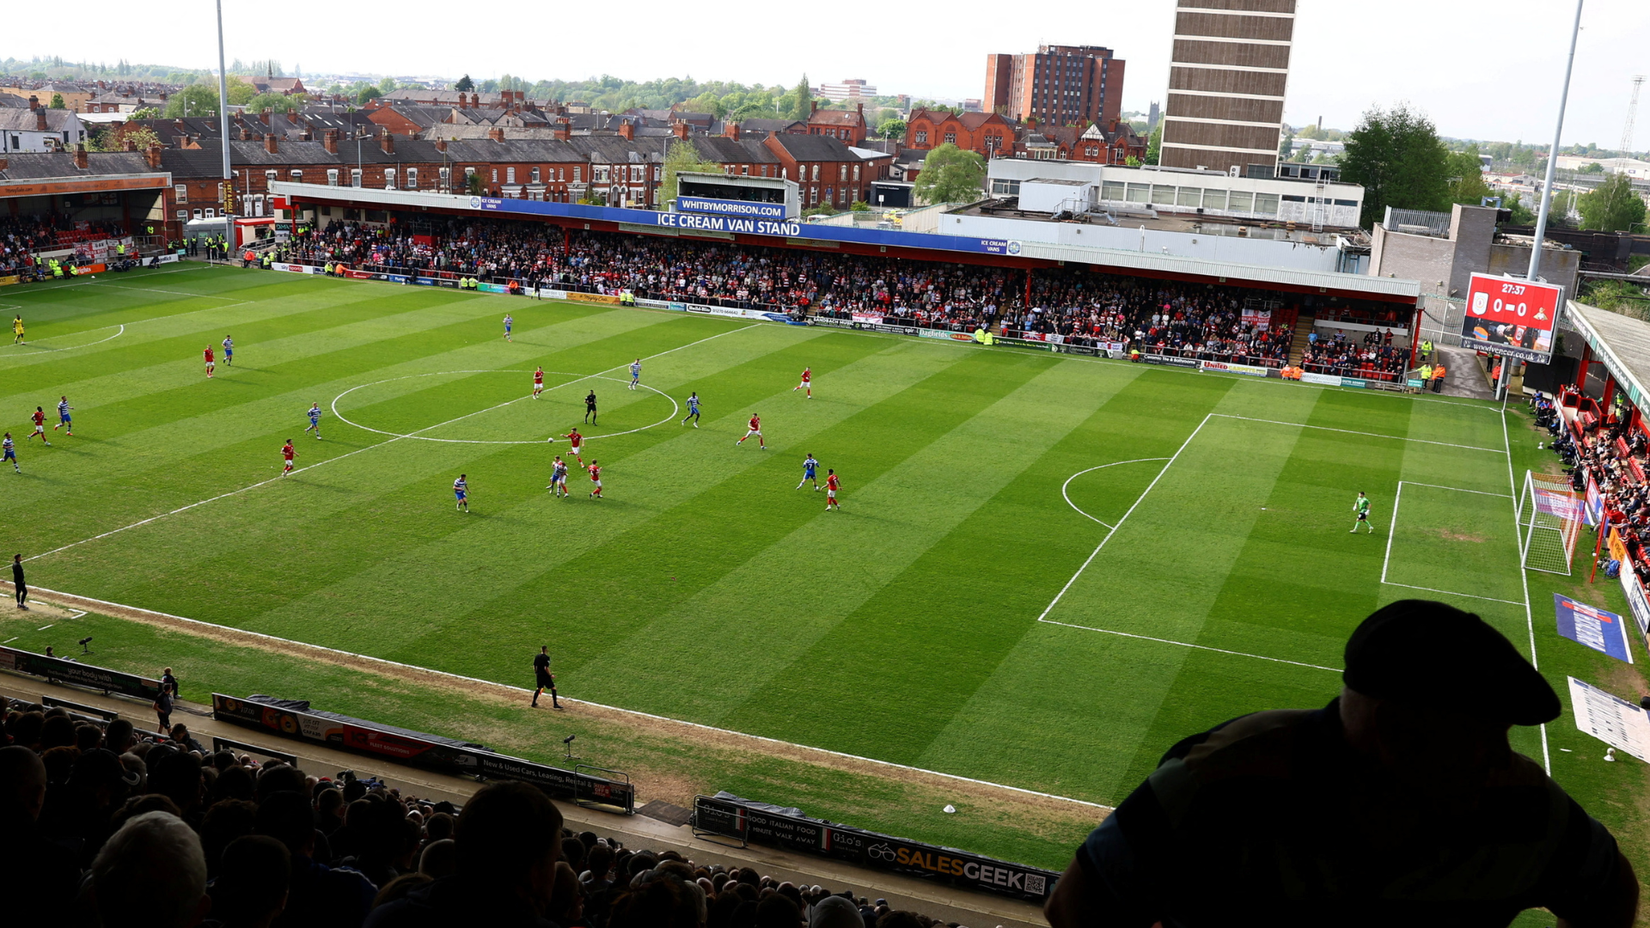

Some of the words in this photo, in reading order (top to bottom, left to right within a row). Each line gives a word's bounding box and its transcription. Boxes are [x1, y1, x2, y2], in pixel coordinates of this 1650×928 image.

[682, 200, 781, 216] WHITBYMORRISON.COM
[658, 213, 676, 226] ICE
[678, 215, 724, 230] CREAM
[727, 218, 754, 232] VAN
[758, 221, 800, 236] STAND
[1502, 283, 1526, 295] 27:37
[1493, 298, 1503, 312] 0
[1517, 302, 1527, 317] 0
[920, 330, 948, 338] Dagfields
[68, 667, 82, 678] your
[82, 668, 98, 680] body
[98, 673, 112, 682] with
[484, 760, 498, 768] New
[504, 764, 520, 773] Used
[521, 767, 536, 778] Cars,
[538, 770, 564, 783] Leasing,
[566, 776, 586, 787] Rental
[752, 826, 772, 836] MINUTE
[775, 832, 792, 840] WALK
[796, 836, 816, 845] AWAY
[769, 820, 794, 831] ITALIAN
[796, 826, 816, 836] FOOD
[832, 832, 862, 847] Gio's
[896, 848, 1023, 890] SALESGEEK
